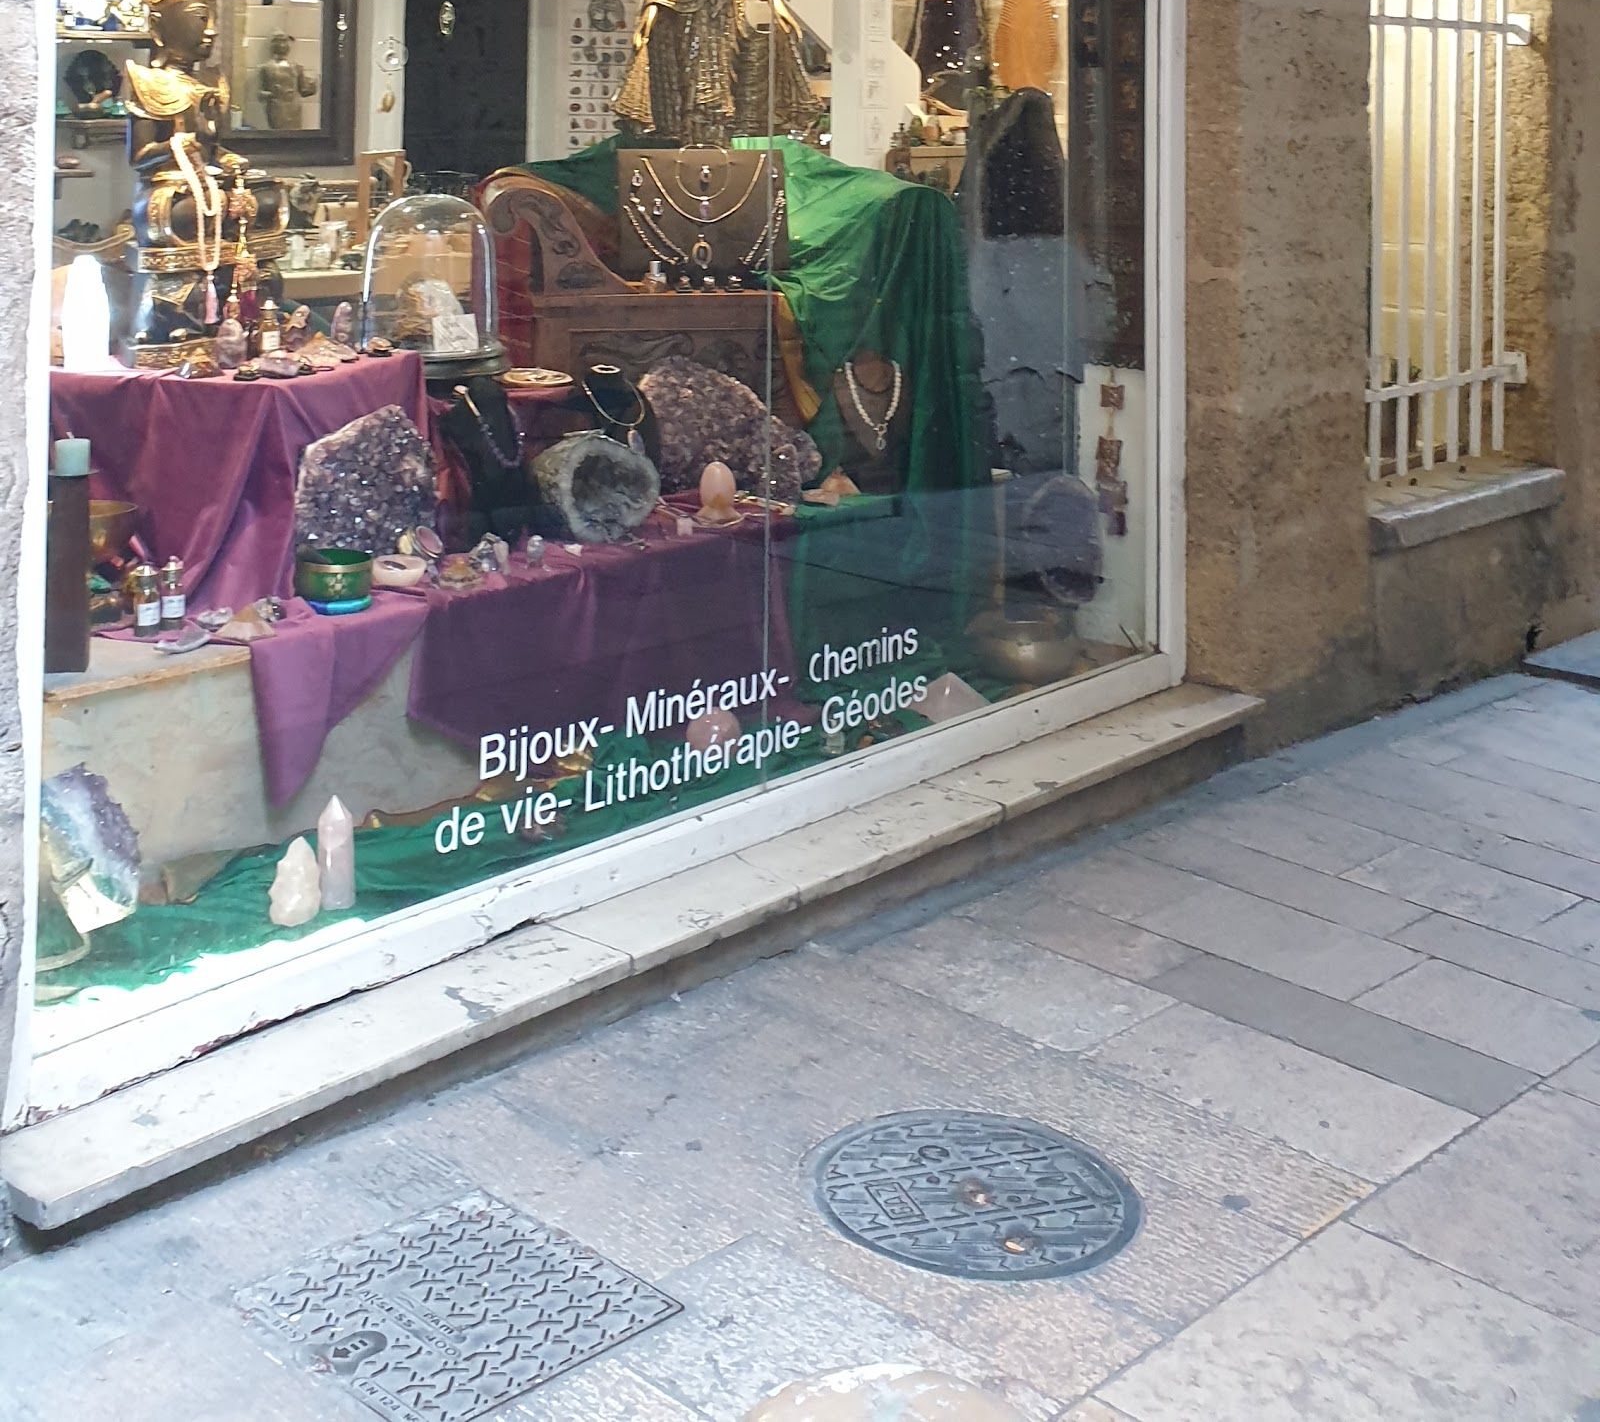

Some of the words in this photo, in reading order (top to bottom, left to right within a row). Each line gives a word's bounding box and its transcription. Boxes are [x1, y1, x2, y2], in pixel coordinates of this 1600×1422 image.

[435, 805, 485, 854] de
[501, 785, 572, 834] vie-
[584, 719, 812, 813] Lithothérapie-
[821, 674, 929, 736] Géodes
[478, 714, 613, 781] Bijoux-
[625, 668, 790, 738] Minéraux-
[809, 625, 919, 683] chemins
